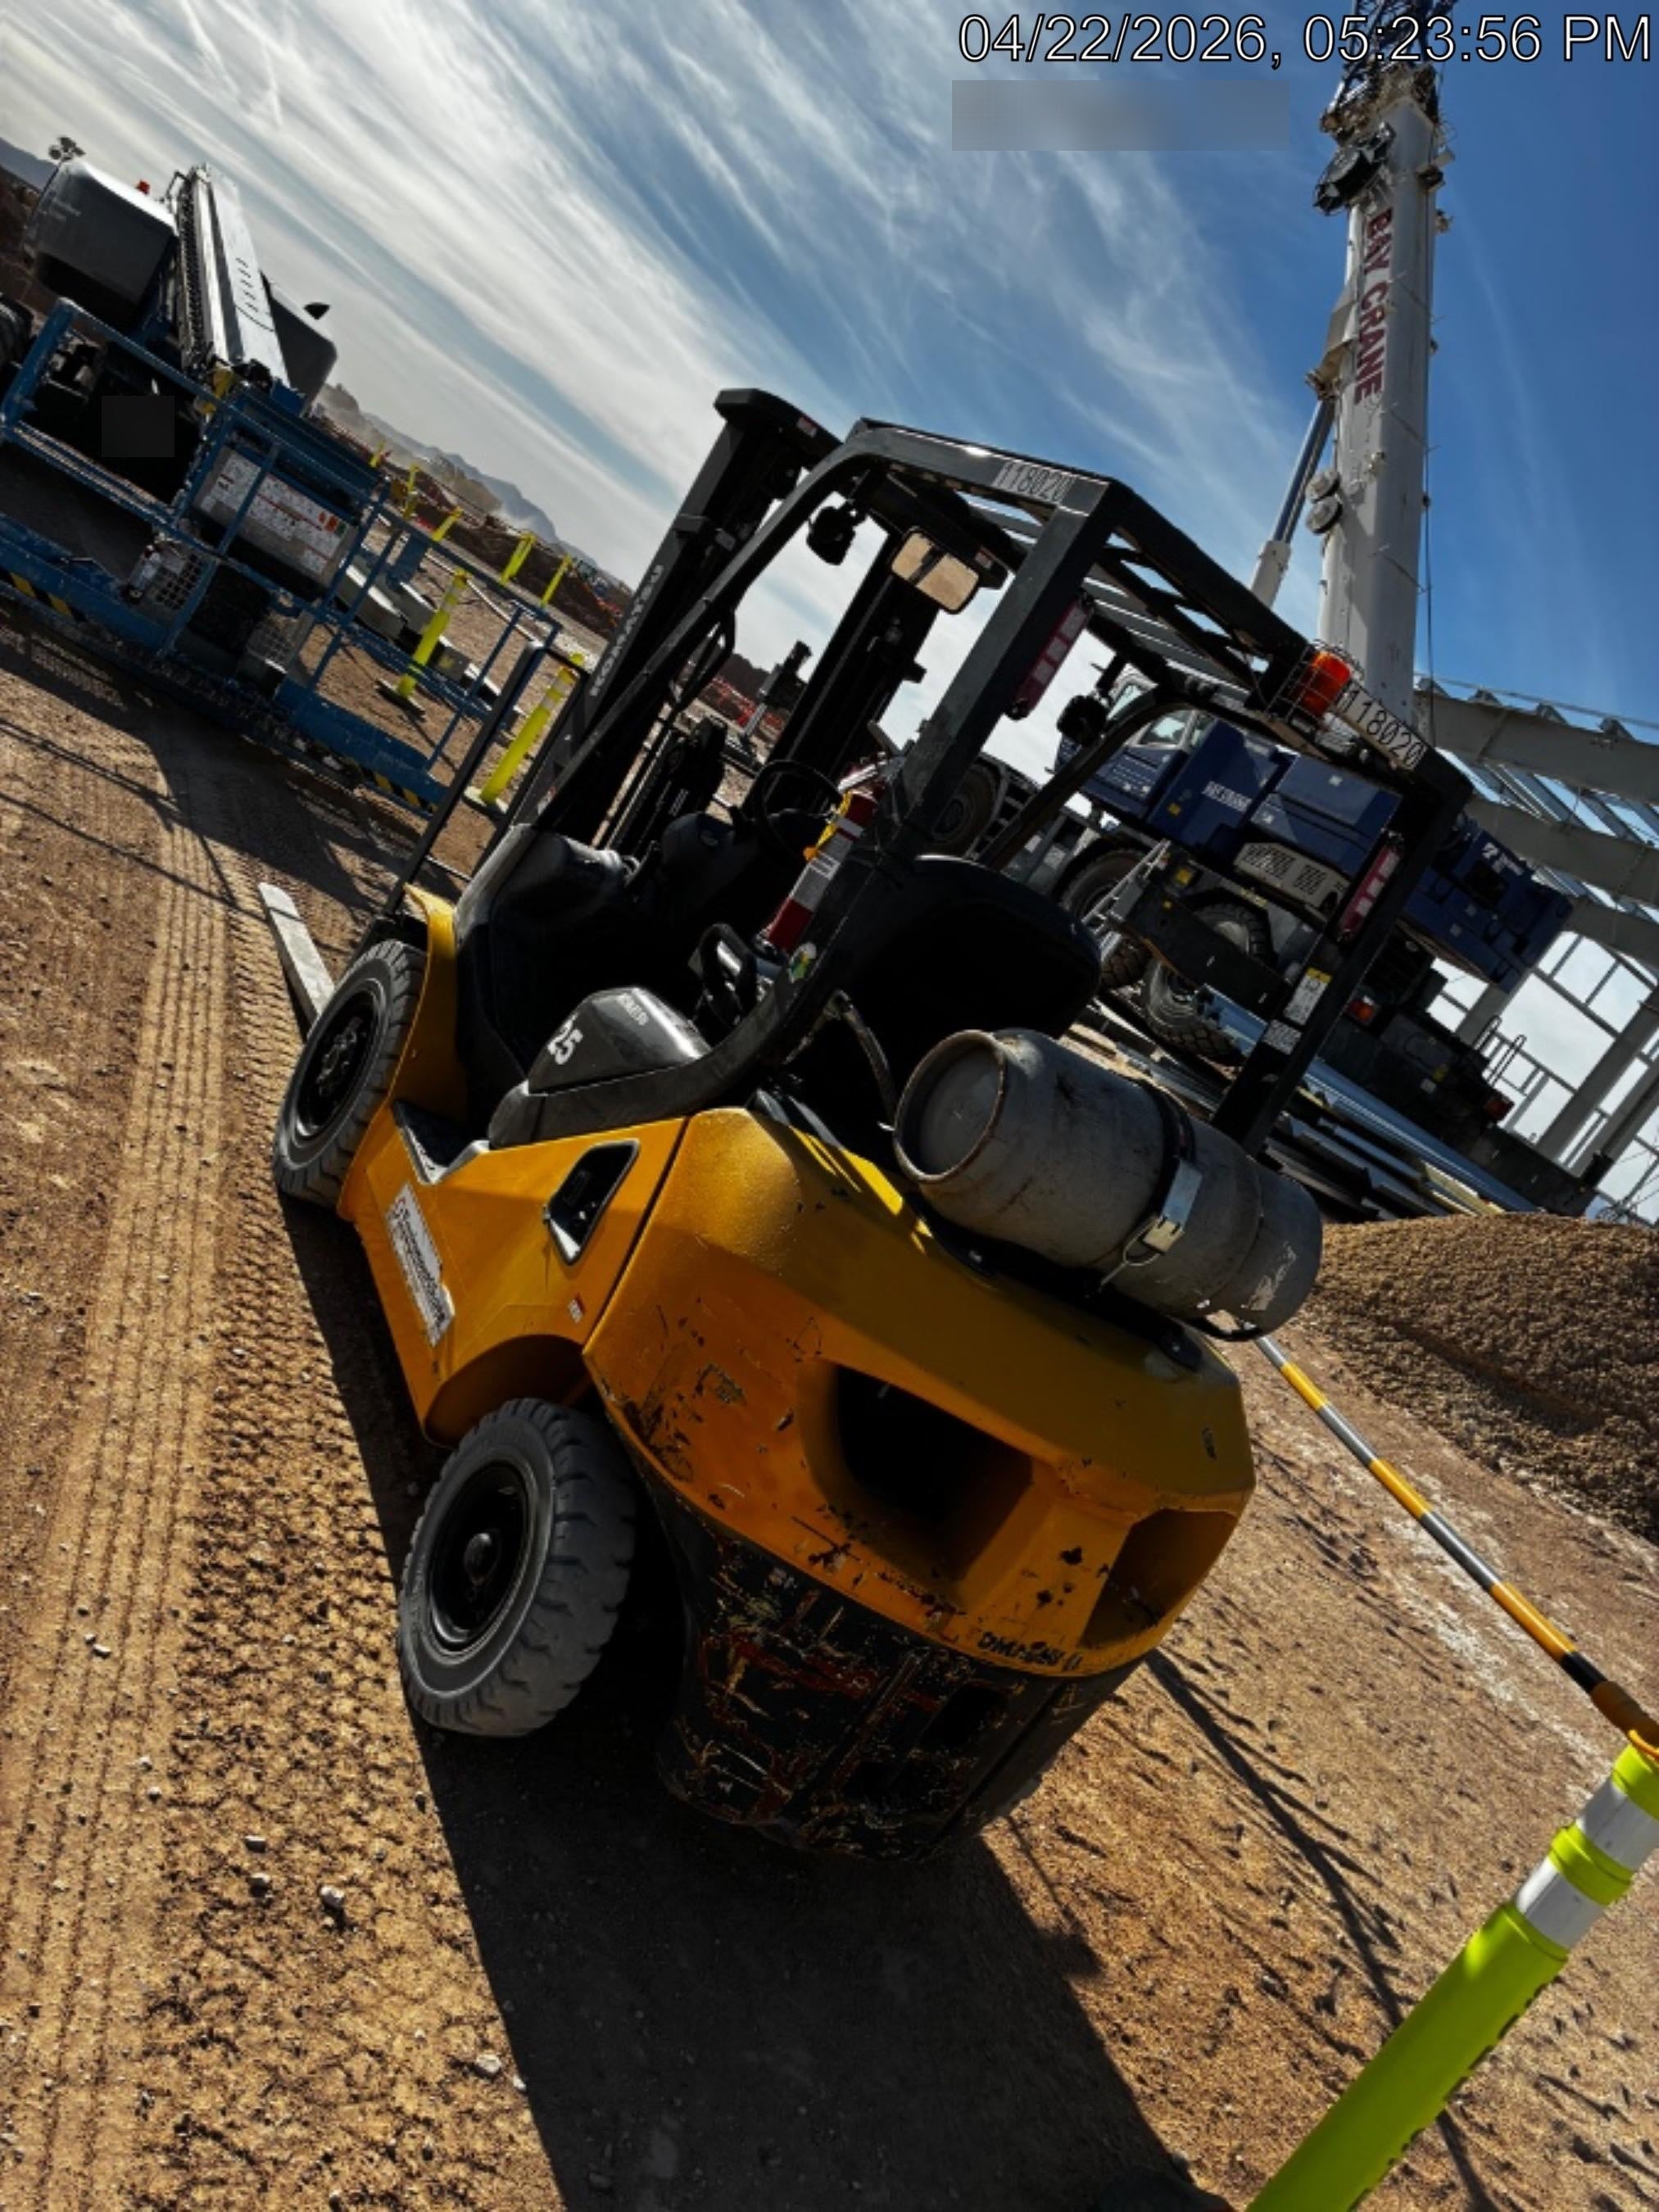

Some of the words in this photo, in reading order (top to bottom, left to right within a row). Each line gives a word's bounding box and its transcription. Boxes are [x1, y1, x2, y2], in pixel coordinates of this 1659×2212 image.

[1364, 208, 1393, 276] BAY
[1354, 280, 1390, 405] CRANE
[1345, 688, 1425, 769] 118020
[547, 1017, 582, 1065] 25
